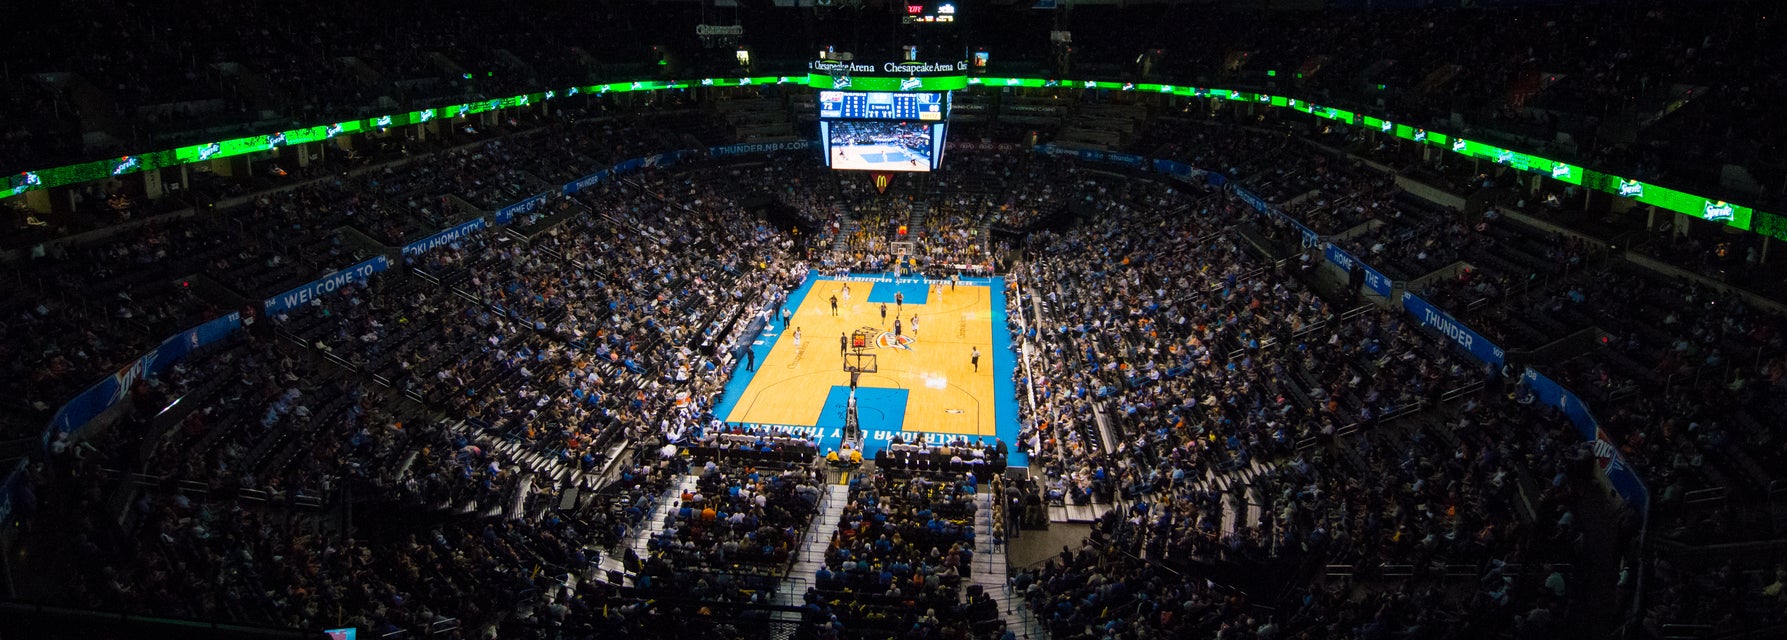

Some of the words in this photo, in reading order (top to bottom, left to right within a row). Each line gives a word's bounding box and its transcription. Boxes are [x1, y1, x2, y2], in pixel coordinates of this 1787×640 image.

[849, 62, 875, 72] Arena
[884, 62, 934, 76] Chesapeake
[934, 62, 954, 72] Arena
[823, 102, 833, 110] 72
[576, 175, 599, 190] THUNDER
[1619, 184, 1642, 198] Sprite
[506, 204, 526, 219] HOME
[526, 200, 536, 212] OF
[1704, 204, 1734, 221] Sprite
[461, 221, 480, 237] CITY
[356, 264, 373, 277] TO
[1334, 250, 1353, 271] HOME
[1364, 270, 1379, 289] THE
[1425, 308, 1473, 351] THUNDER
[1594, 440, 1614, 458] OKC
